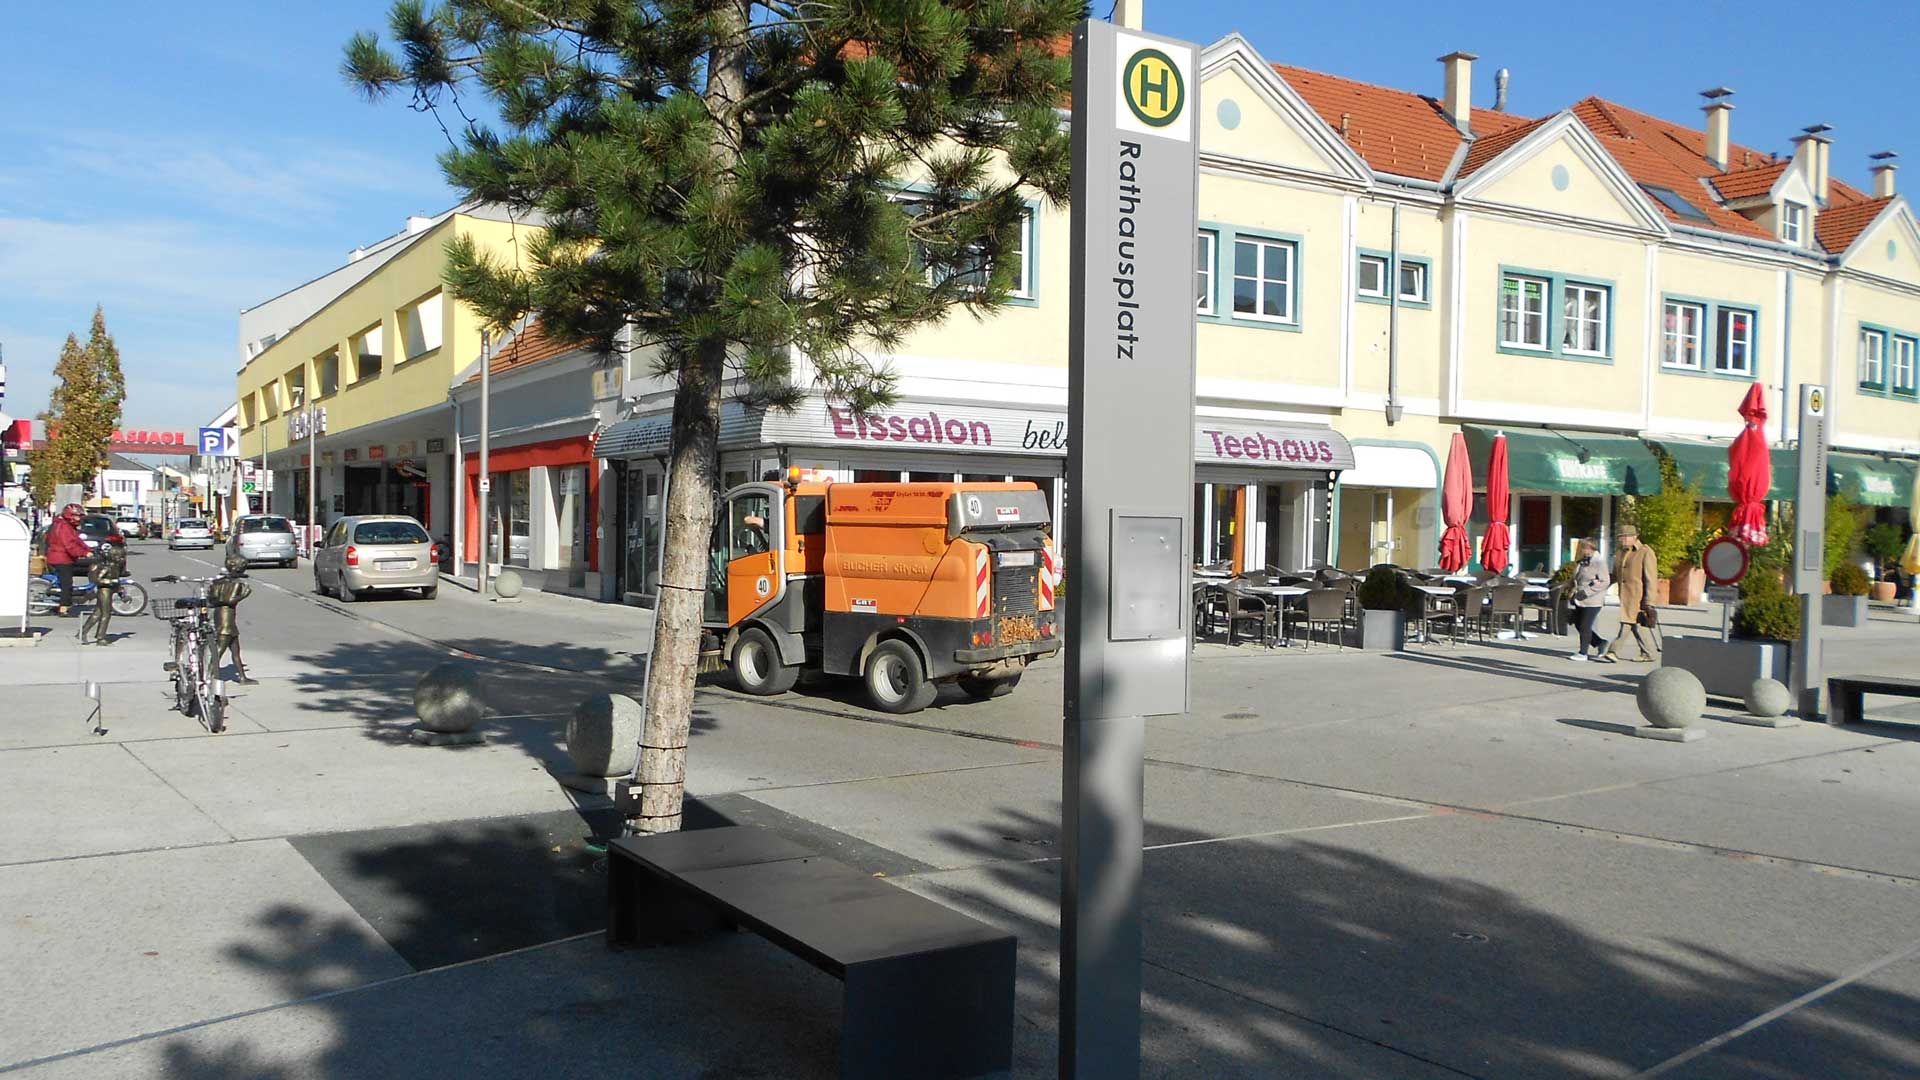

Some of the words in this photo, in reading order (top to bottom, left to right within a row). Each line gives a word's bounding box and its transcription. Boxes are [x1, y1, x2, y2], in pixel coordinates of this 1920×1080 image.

[1140, 64, 1168, 112] H
[1112, 140, 1141, 360] Rathausplatz
[111, 430, 186, 445] ASSAGE
[833, 412, 992, 446] Eissalon
[1022, 419, 1068, 449] bel
[205, 436, 219, 450] P
[1203, 430, 1333, 462] Teehaus
[970, 500, 979, 514] 40
[843, 561, 888, 573] BUCHER
[758, 580, 768, 593] 40
